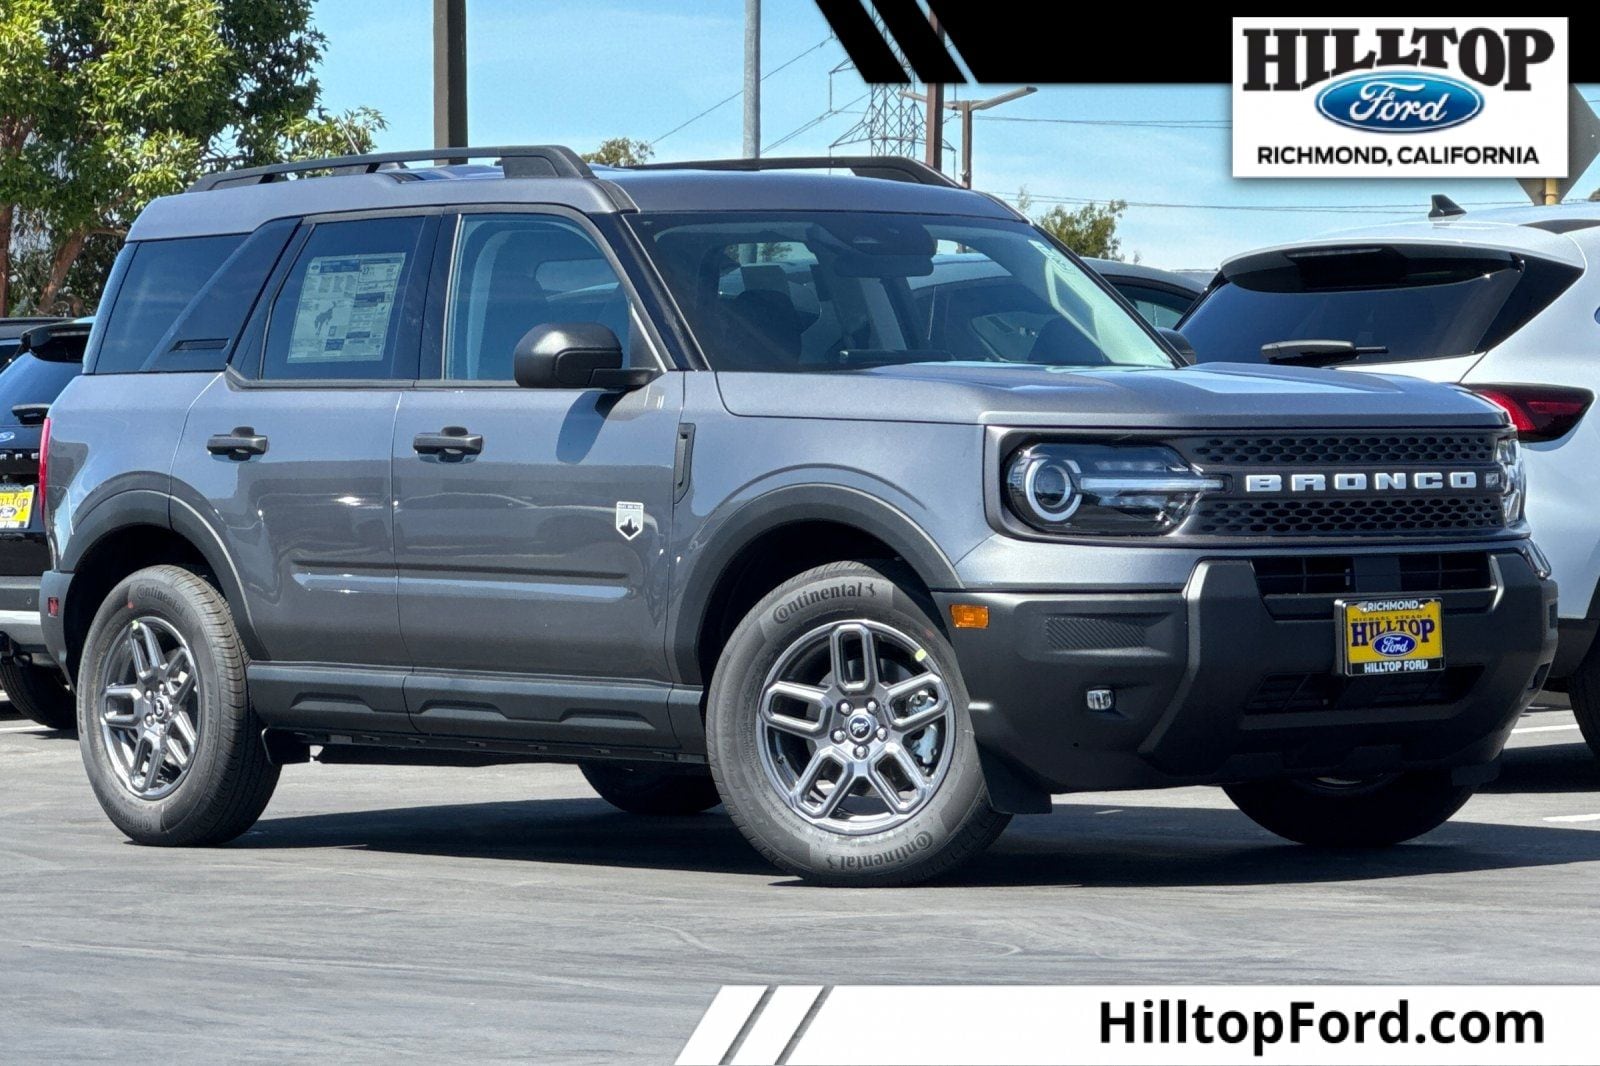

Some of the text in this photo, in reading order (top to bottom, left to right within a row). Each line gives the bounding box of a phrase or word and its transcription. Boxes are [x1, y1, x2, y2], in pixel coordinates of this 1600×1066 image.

[1246, 472, 1476, 492] BRONCO
[772, 581, 862, 625] Continental
[1367, 600, 1419, 611] RICHMOND
[1351, 618, 1435, 647] HILLTOP
[1381, 636, 1408, 653] Ford
[1364, 660, 1428, 673] HILLTOP FORD
[840, 831, 933, 871] Continental
